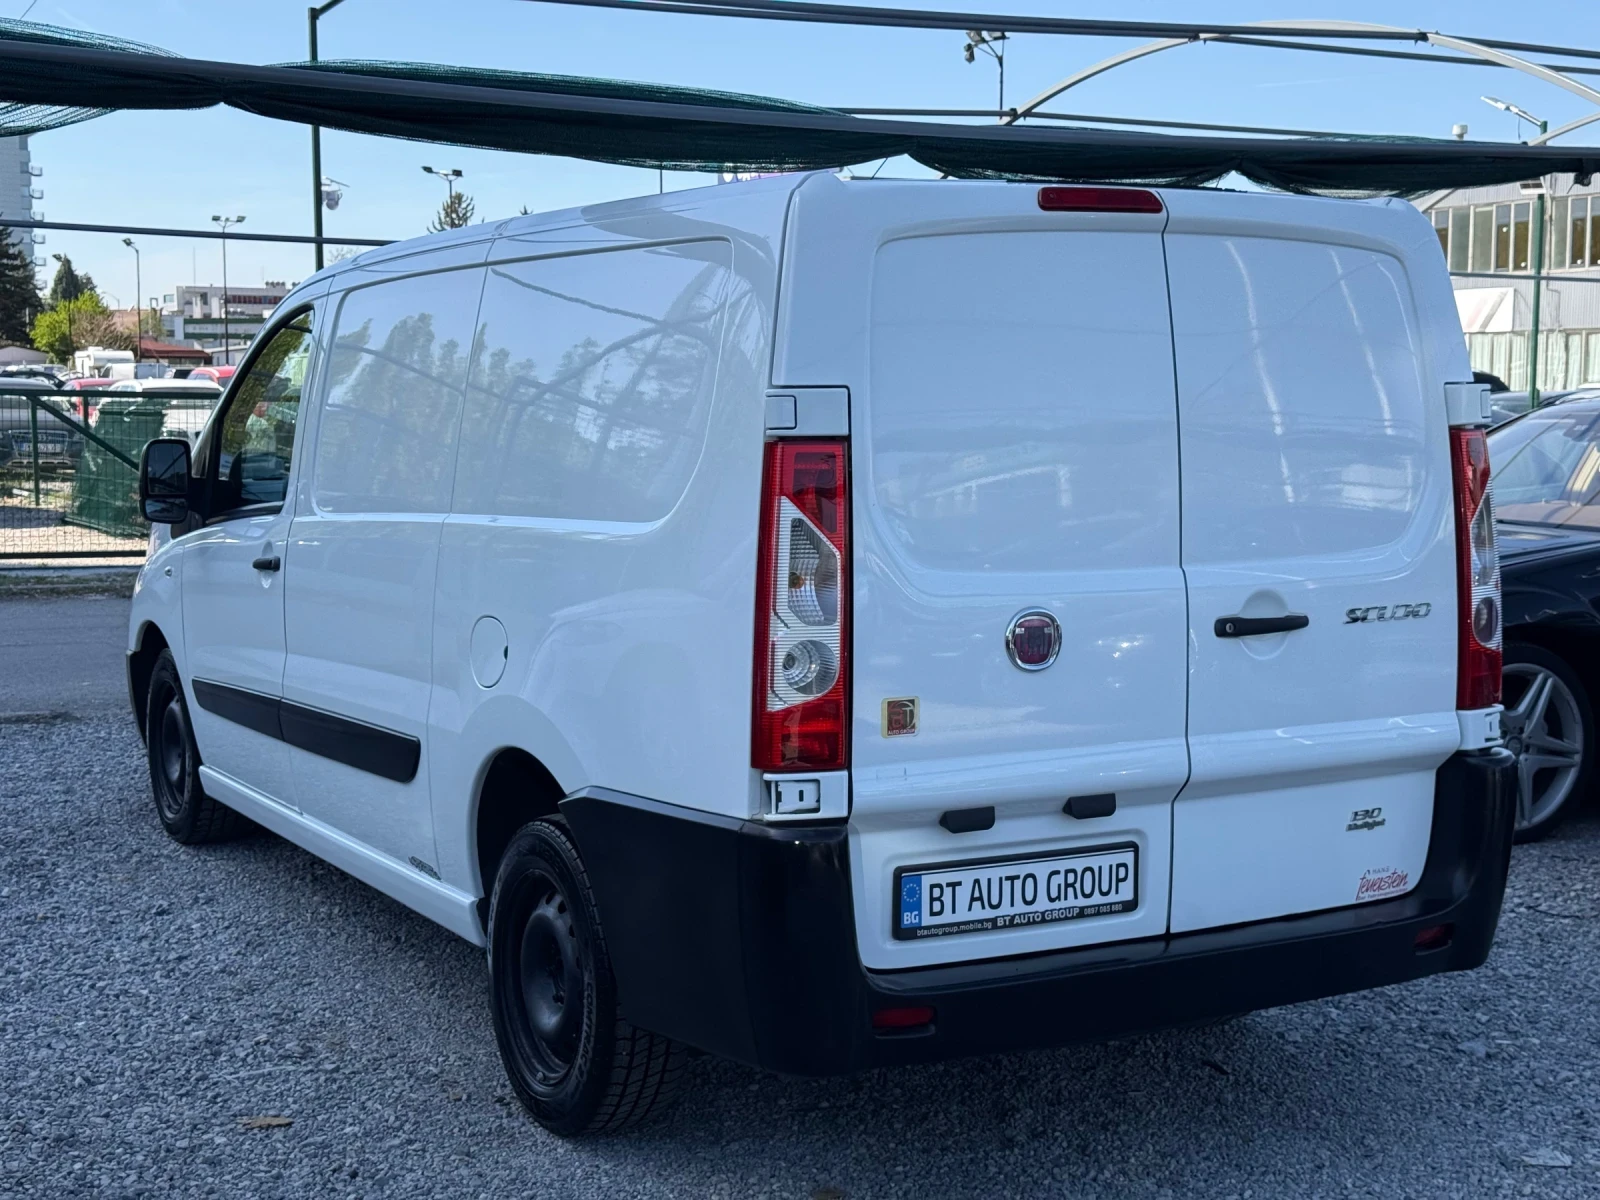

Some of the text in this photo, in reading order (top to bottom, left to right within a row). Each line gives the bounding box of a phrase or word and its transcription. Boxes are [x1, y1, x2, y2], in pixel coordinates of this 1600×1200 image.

[1343, 602, 1432, 624] SCUDO
[1350, 807, 1382, 822] 130
[929, 863, 1129, 917] BT AUTO GROUP
[904, 911, 919, 924] BG
[917, 921, 992, 936] btautogroup.mobile.bg
[997, 916, 1011, 926] BT
[1013, 913, 1041, 924] AUTO
[1045, 907, 1080, 920] GROUP
